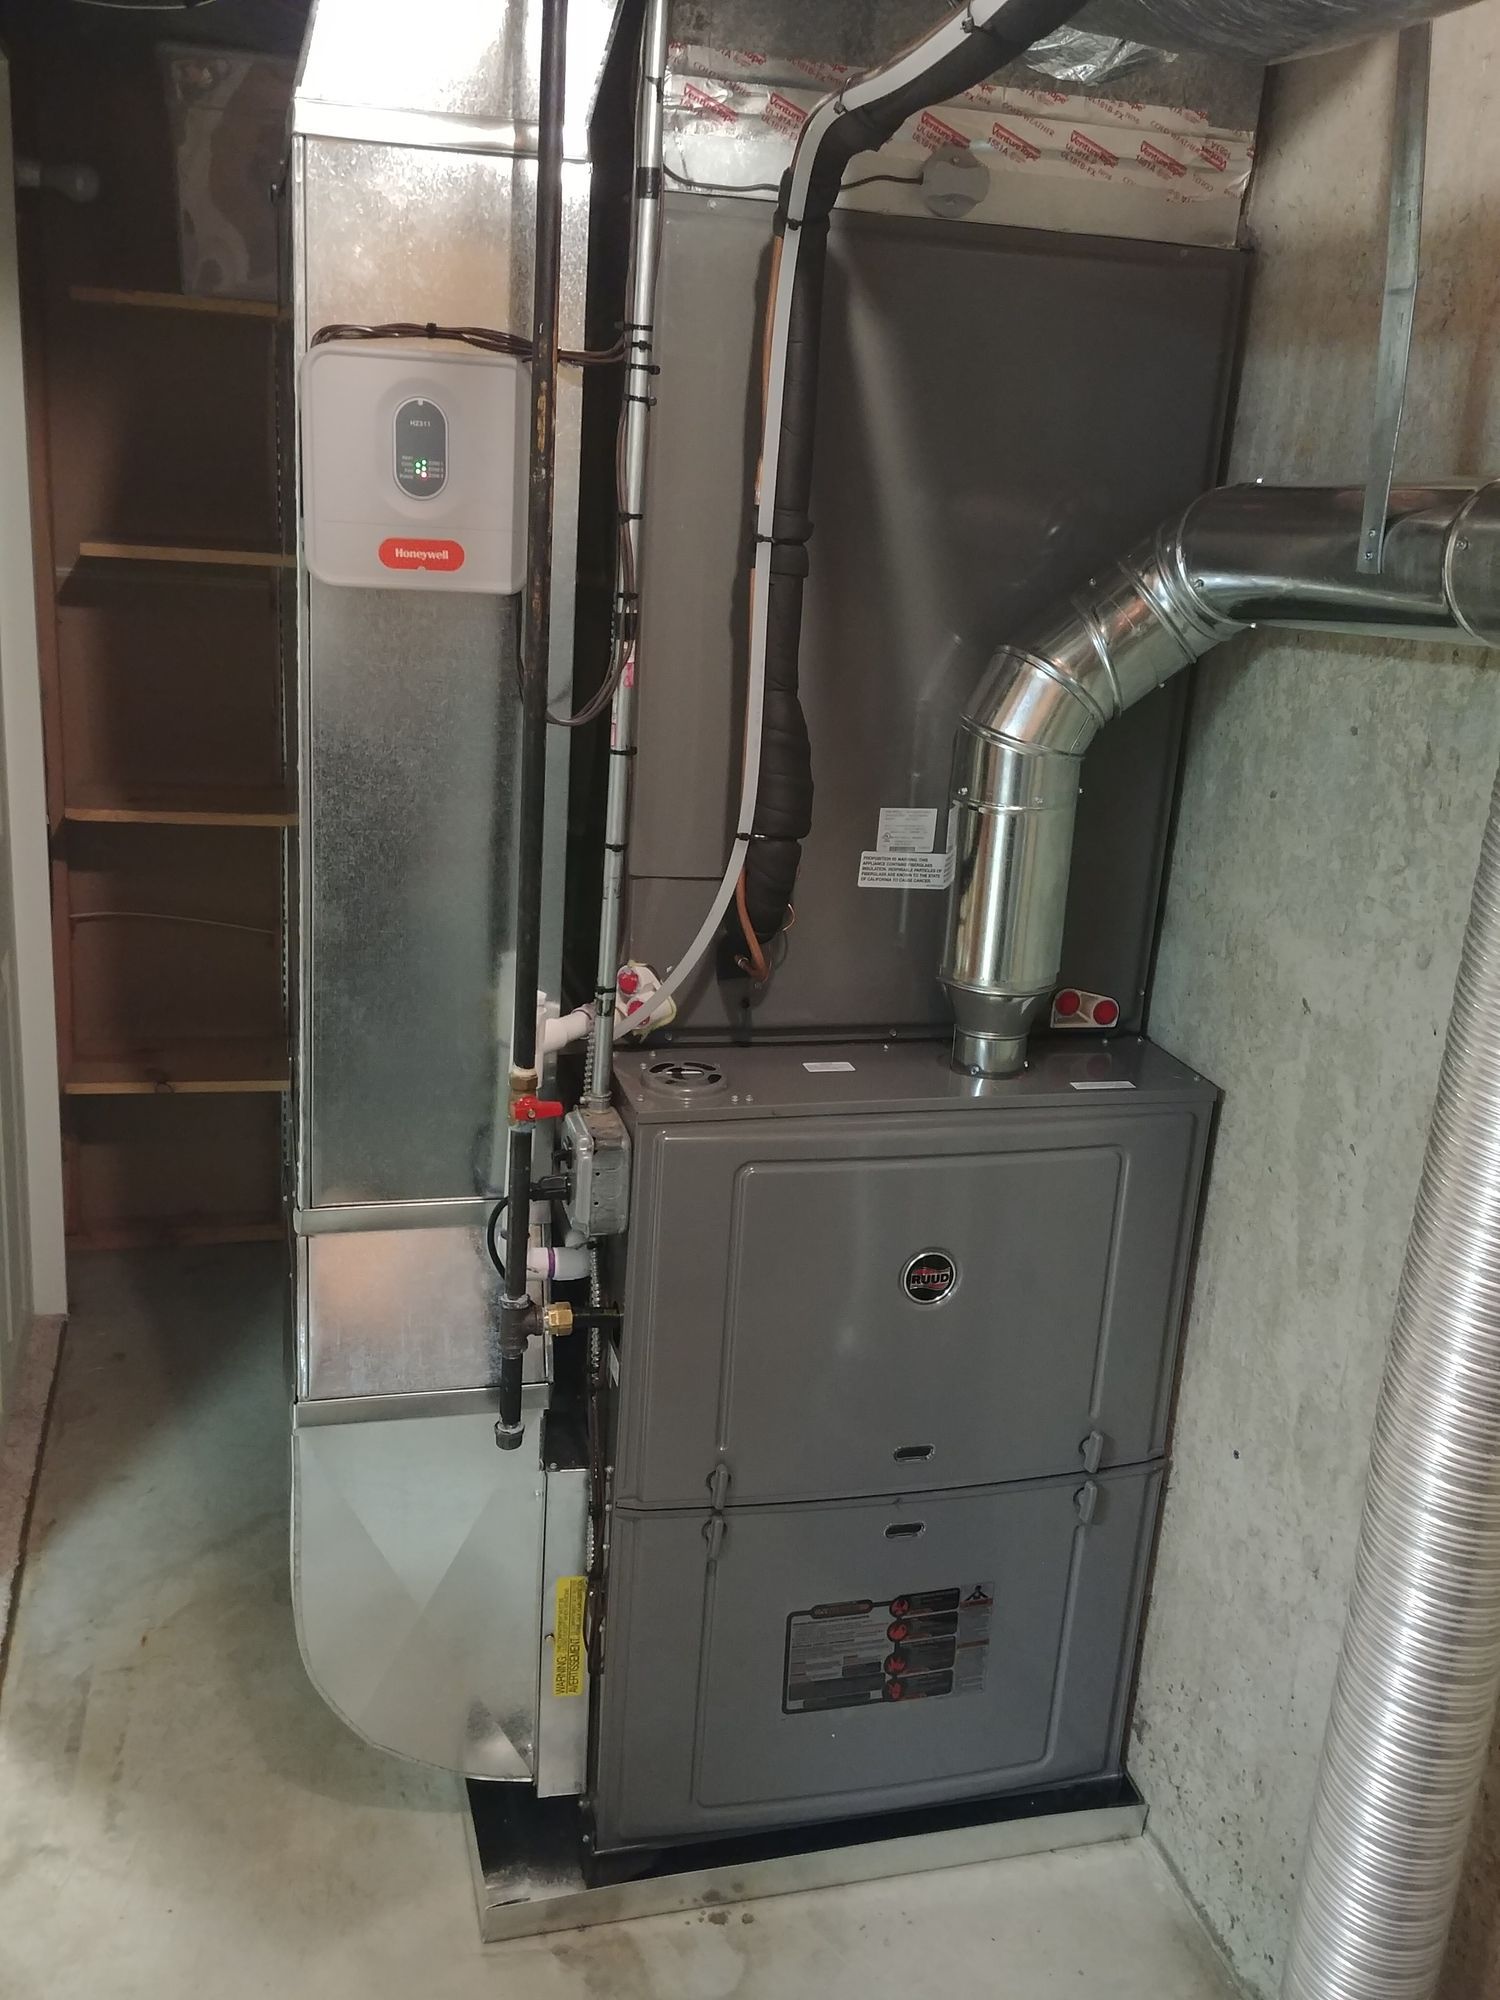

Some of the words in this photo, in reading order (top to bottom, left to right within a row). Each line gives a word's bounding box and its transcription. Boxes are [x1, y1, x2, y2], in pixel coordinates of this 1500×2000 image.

[770, 93, 806, 124] VentureT
[991, 124, 1041, 161] VentureTape
[1070, 132, 1118, 168] VentureTape
[1140, 143, 1187, 178] VentureTape
[410, 420, 430, 428] HZ311
[395, 548, 449, 560] Honeywell
[912, 1273, 949, 1284] RUUD
[556, 1656, 567, 1694] WARNING
[569, 1638, 580, 1693] AVERTISSEMENT
